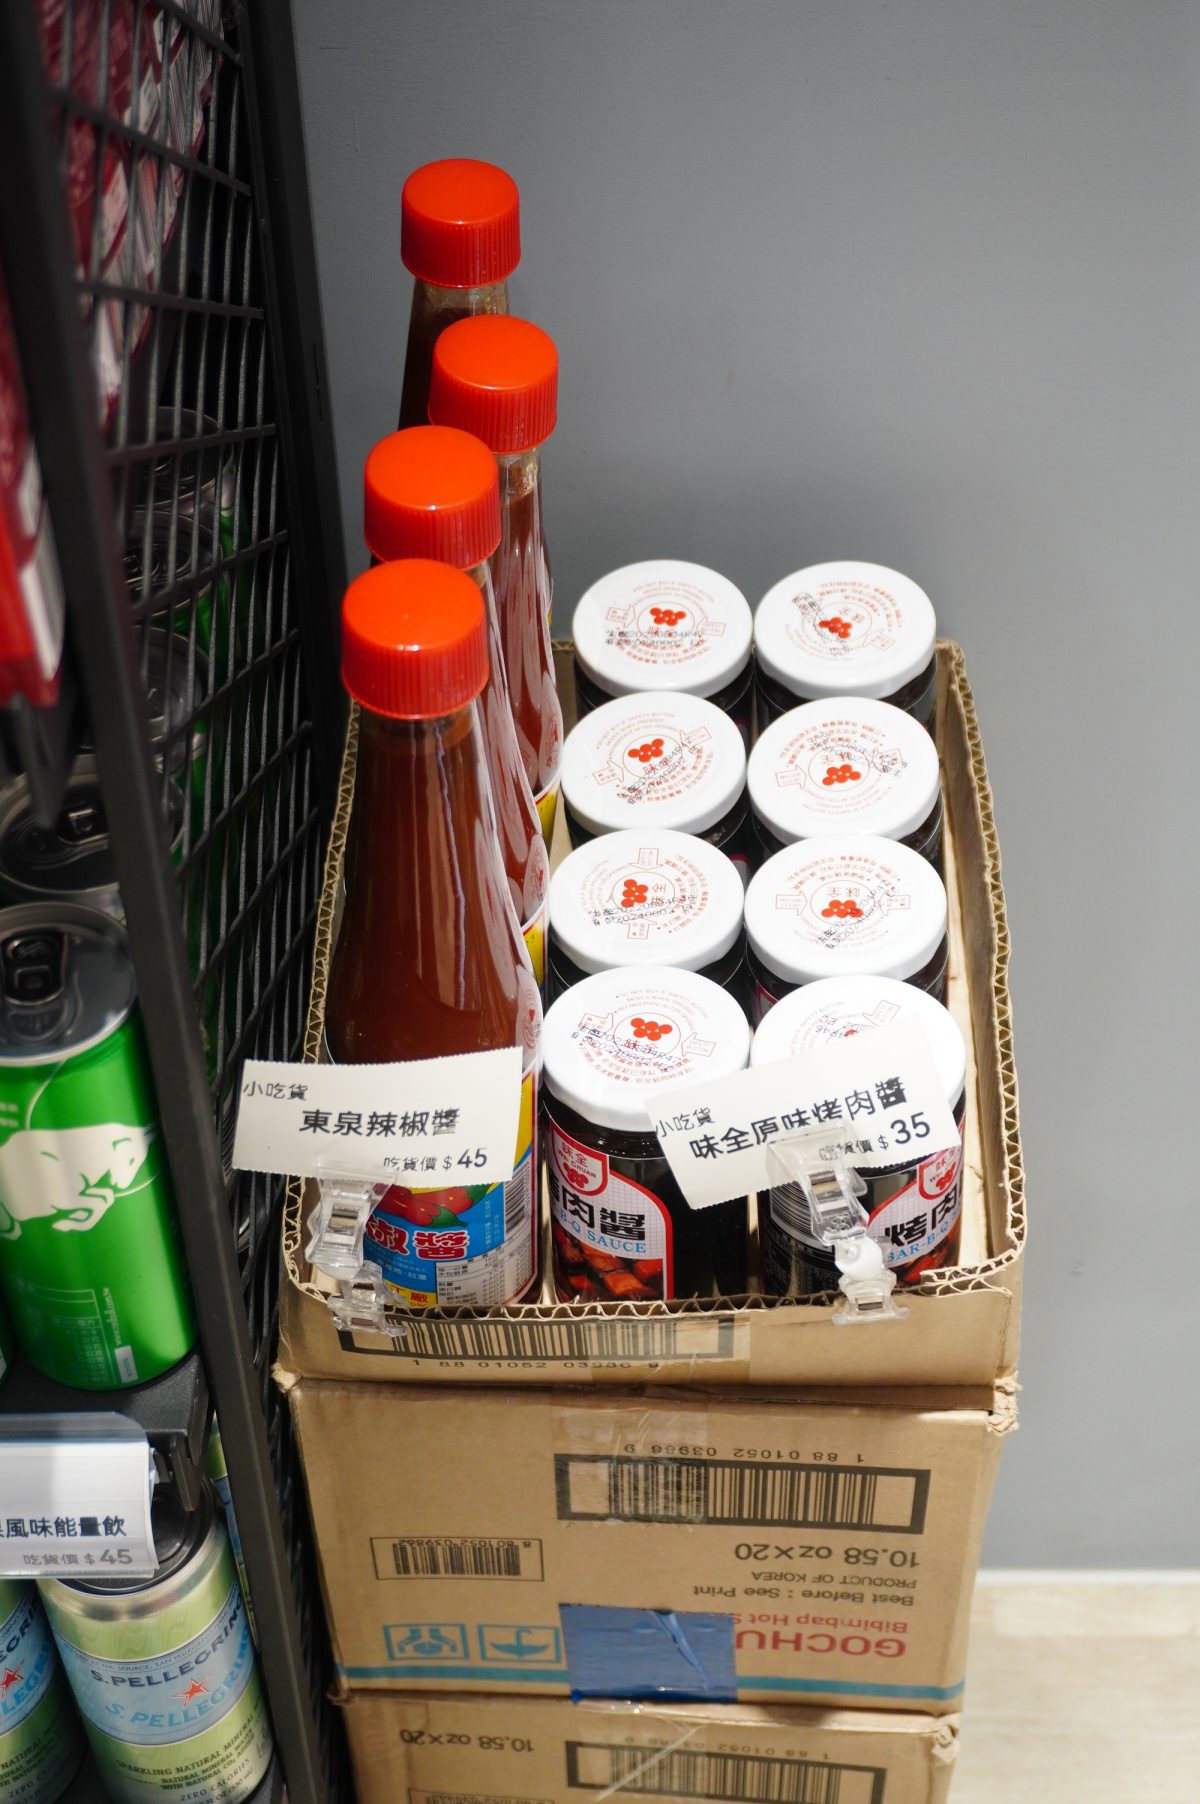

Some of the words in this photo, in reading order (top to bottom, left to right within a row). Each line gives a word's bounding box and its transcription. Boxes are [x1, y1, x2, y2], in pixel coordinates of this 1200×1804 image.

[243, 1081, 309, 1101] 小吃貨
[298, 1108, 461, 1138] 東泉辣椒醬
[655, 1107, 715, 1138] 小吃貨
[688, 1076, 909, 1161] 味全原味烤肉醬
[587, 1228, 647, 1254] SAUCE
[733, 1447, 801, 1461] 01052
[812, 1451, 840, 1462] 88
[843, 1546, 921, 1569] 10.58
[751, 1570, 807, 1583] KOREA
[811, 1573, 834, 1584] OF
[840, 1574, 918, 1589] PRODUCT
[692, 1584, 737, 1598] Print
[743, 1586, 781, 1599] See
[801, 1588, 865, 1604] Before
[871, 1593, 915, 1607] Best
[748, 1612, 789, 1626] Hot
[796, 1612, 909, 1634] Bibimbap
[477, 1736, 535, 1753] 10.58
[175, 1750, 222, 1774] NATURAL
[160, 1772, 199, 1784] NATURAL
[180, 1789, 207, 1802] ZERO
